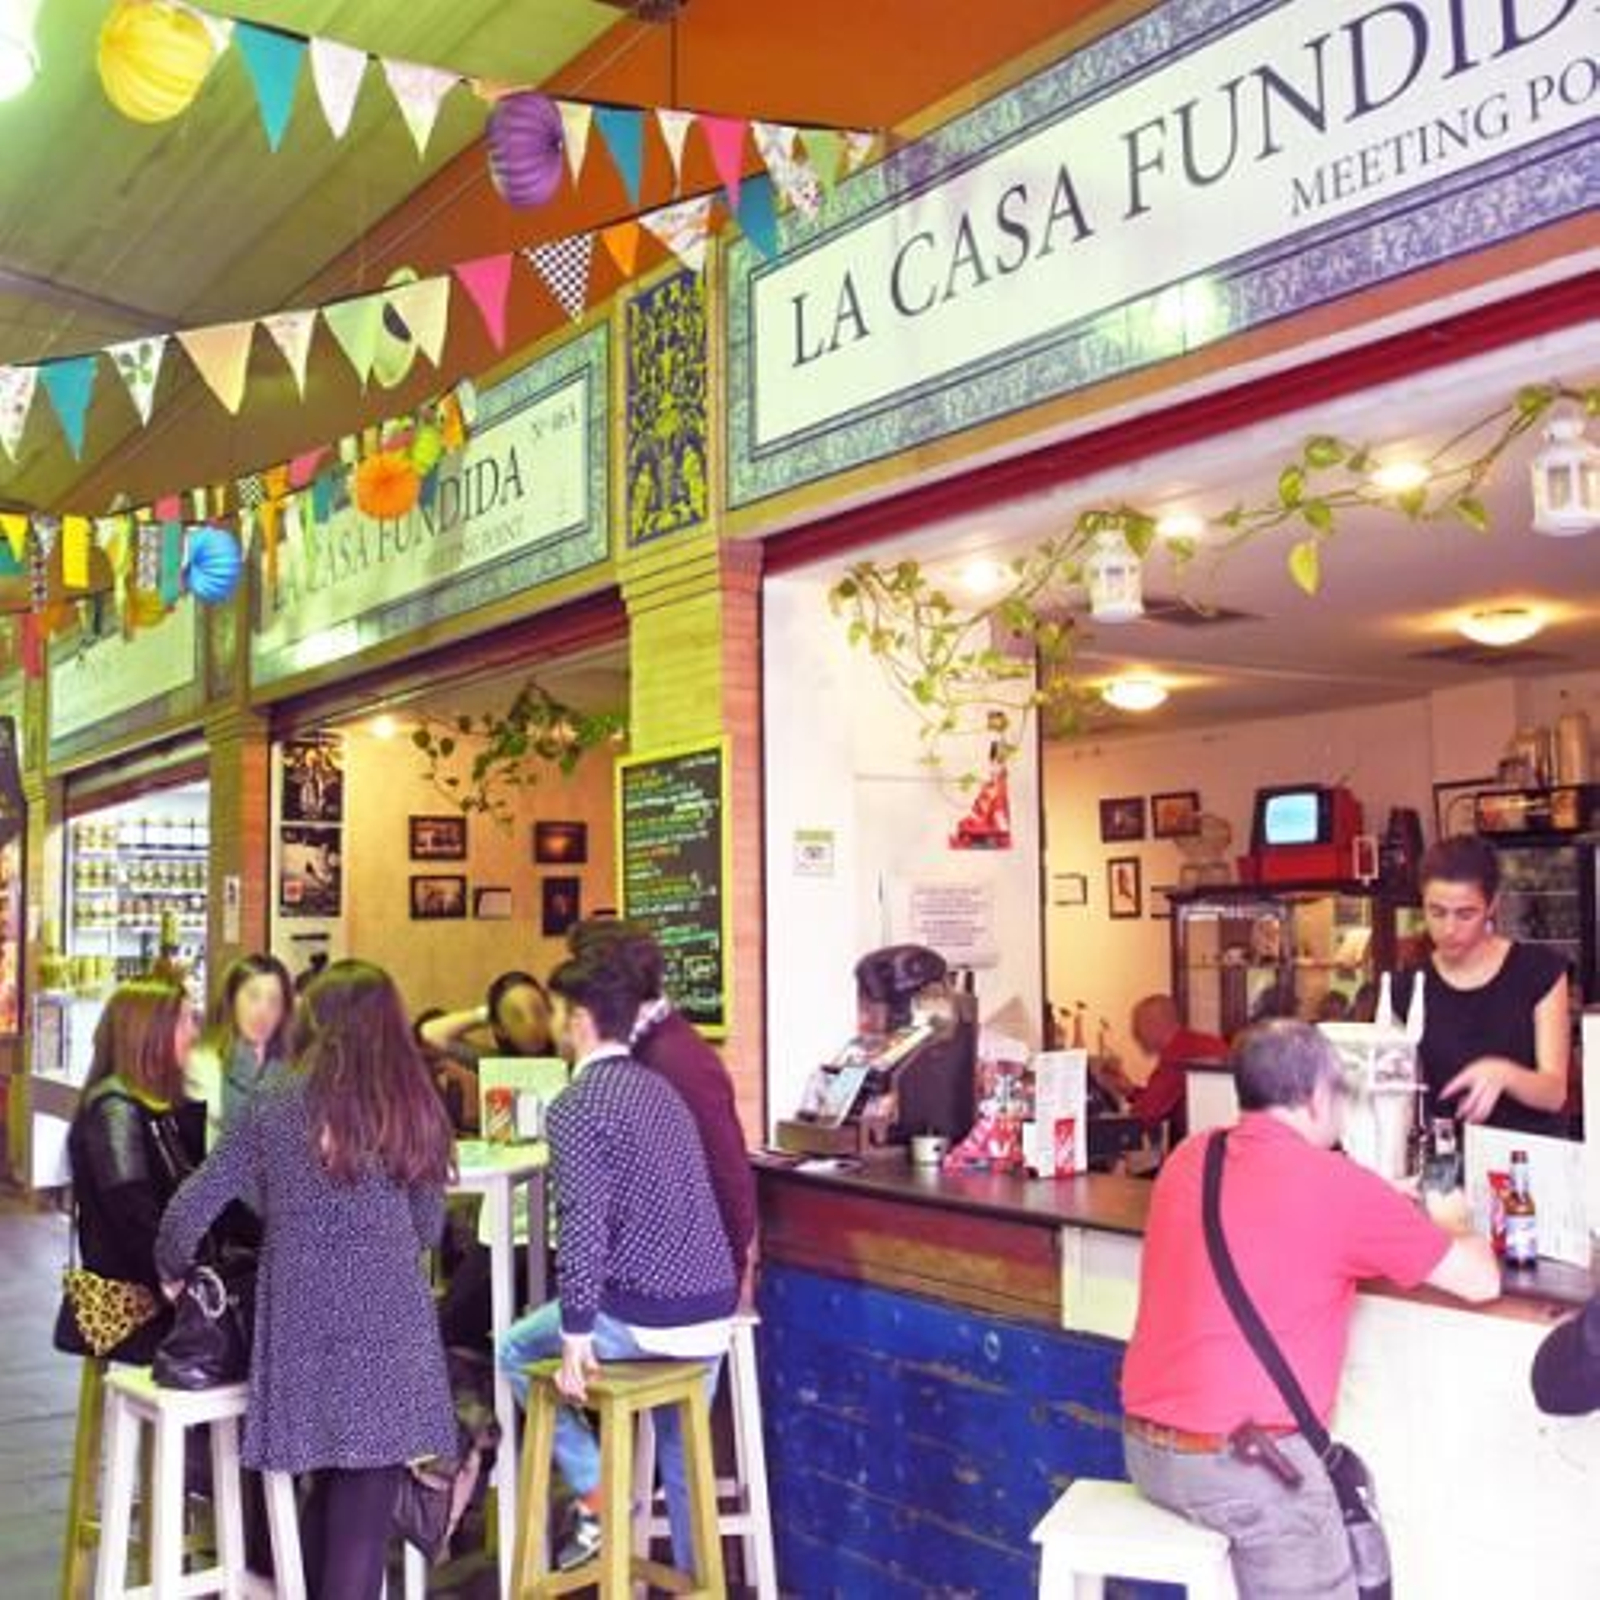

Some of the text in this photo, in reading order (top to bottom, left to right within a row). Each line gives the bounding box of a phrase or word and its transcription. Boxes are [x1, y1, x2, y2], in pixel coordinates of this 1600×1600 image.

[792, 0, 1600, 367] LA CASA FUNDID
[1291, 58, 1600, 217] MEETING PO
